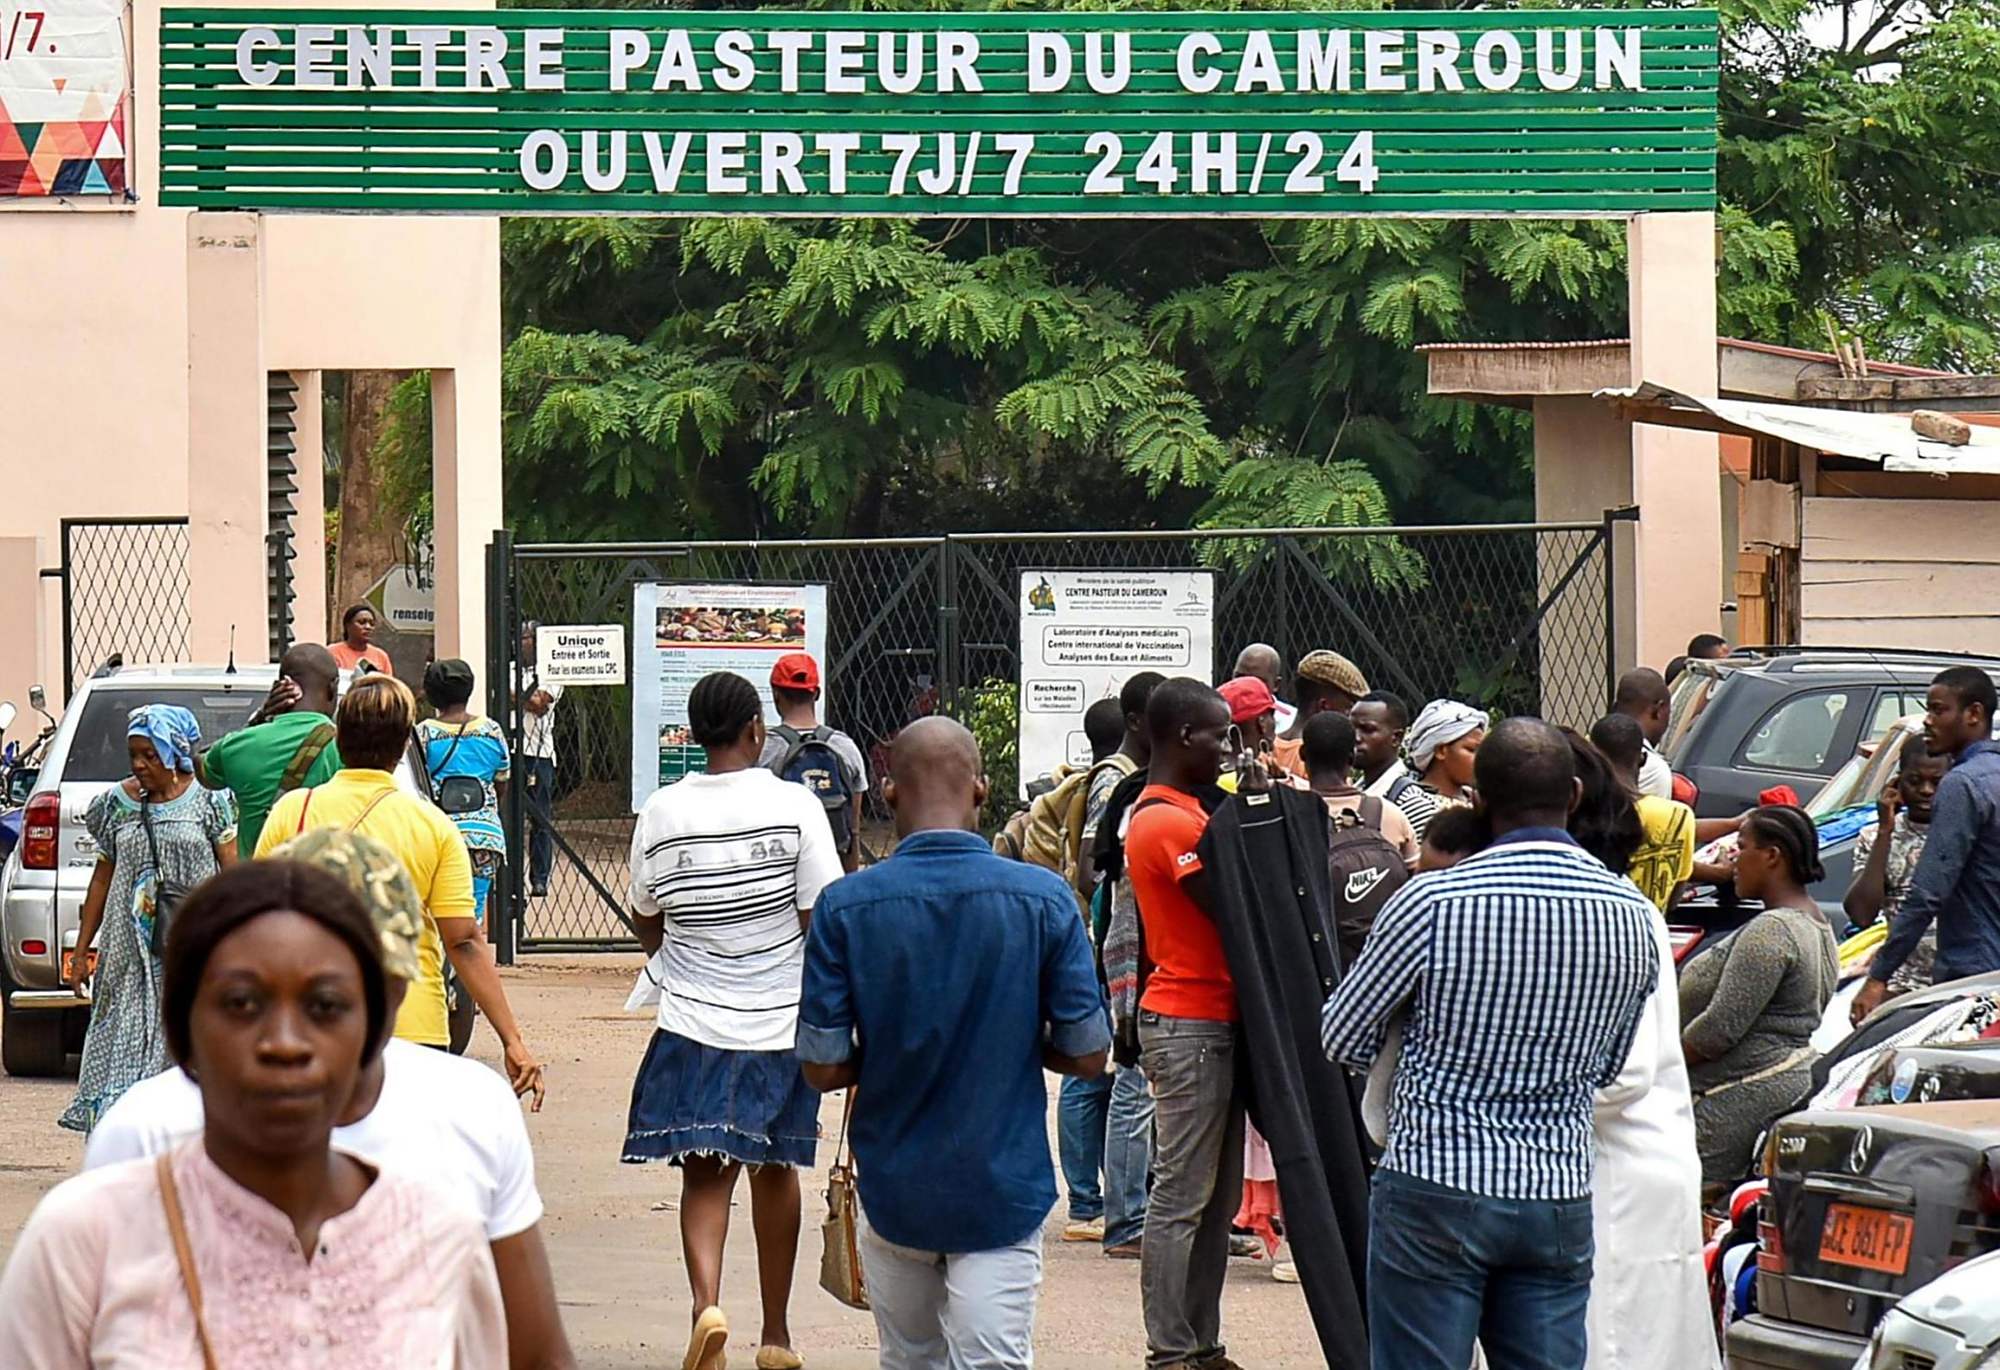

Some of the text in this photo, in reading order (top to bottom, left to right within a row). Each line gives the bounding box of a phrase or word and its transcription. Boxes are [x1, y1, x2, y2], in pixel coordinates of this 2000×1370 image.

[0, 11, 56, 60] /7.
[236, 27, 1643, 93] CENTRE PASTEUR DU CAMEROUN
[519, 128, 1380, 195] OUVERT 7J/7 24H/24
[1065, 588, 1168, 597] CENTRE PASTEUR DU CAMEROUN
[1053, 628, 1097, 636] Laboratoire
[1099, 628, 1139, 638] d'Analyses
[558, 635, 605, 648] Unique
[1048, 640, 1184, 650] Centre international de Vaccinations
[578, 650, 586, 659] et
[588, 648, 610, 659] Sortie
[1059, 653, 1092, 662] Analyses
[1110, 653, 1128, 661] Eaux
[1140, 653, 1173, 662] Aliments
[548, 664, 560, 675] Pour
[562, 664, 570, 675] les
[572, 665, 596, 675] examens
[598, 665, 604, 674] au
[1034, 684, 1077, 693] Recherche
[1351, 869, 1378, 888] NIKE
